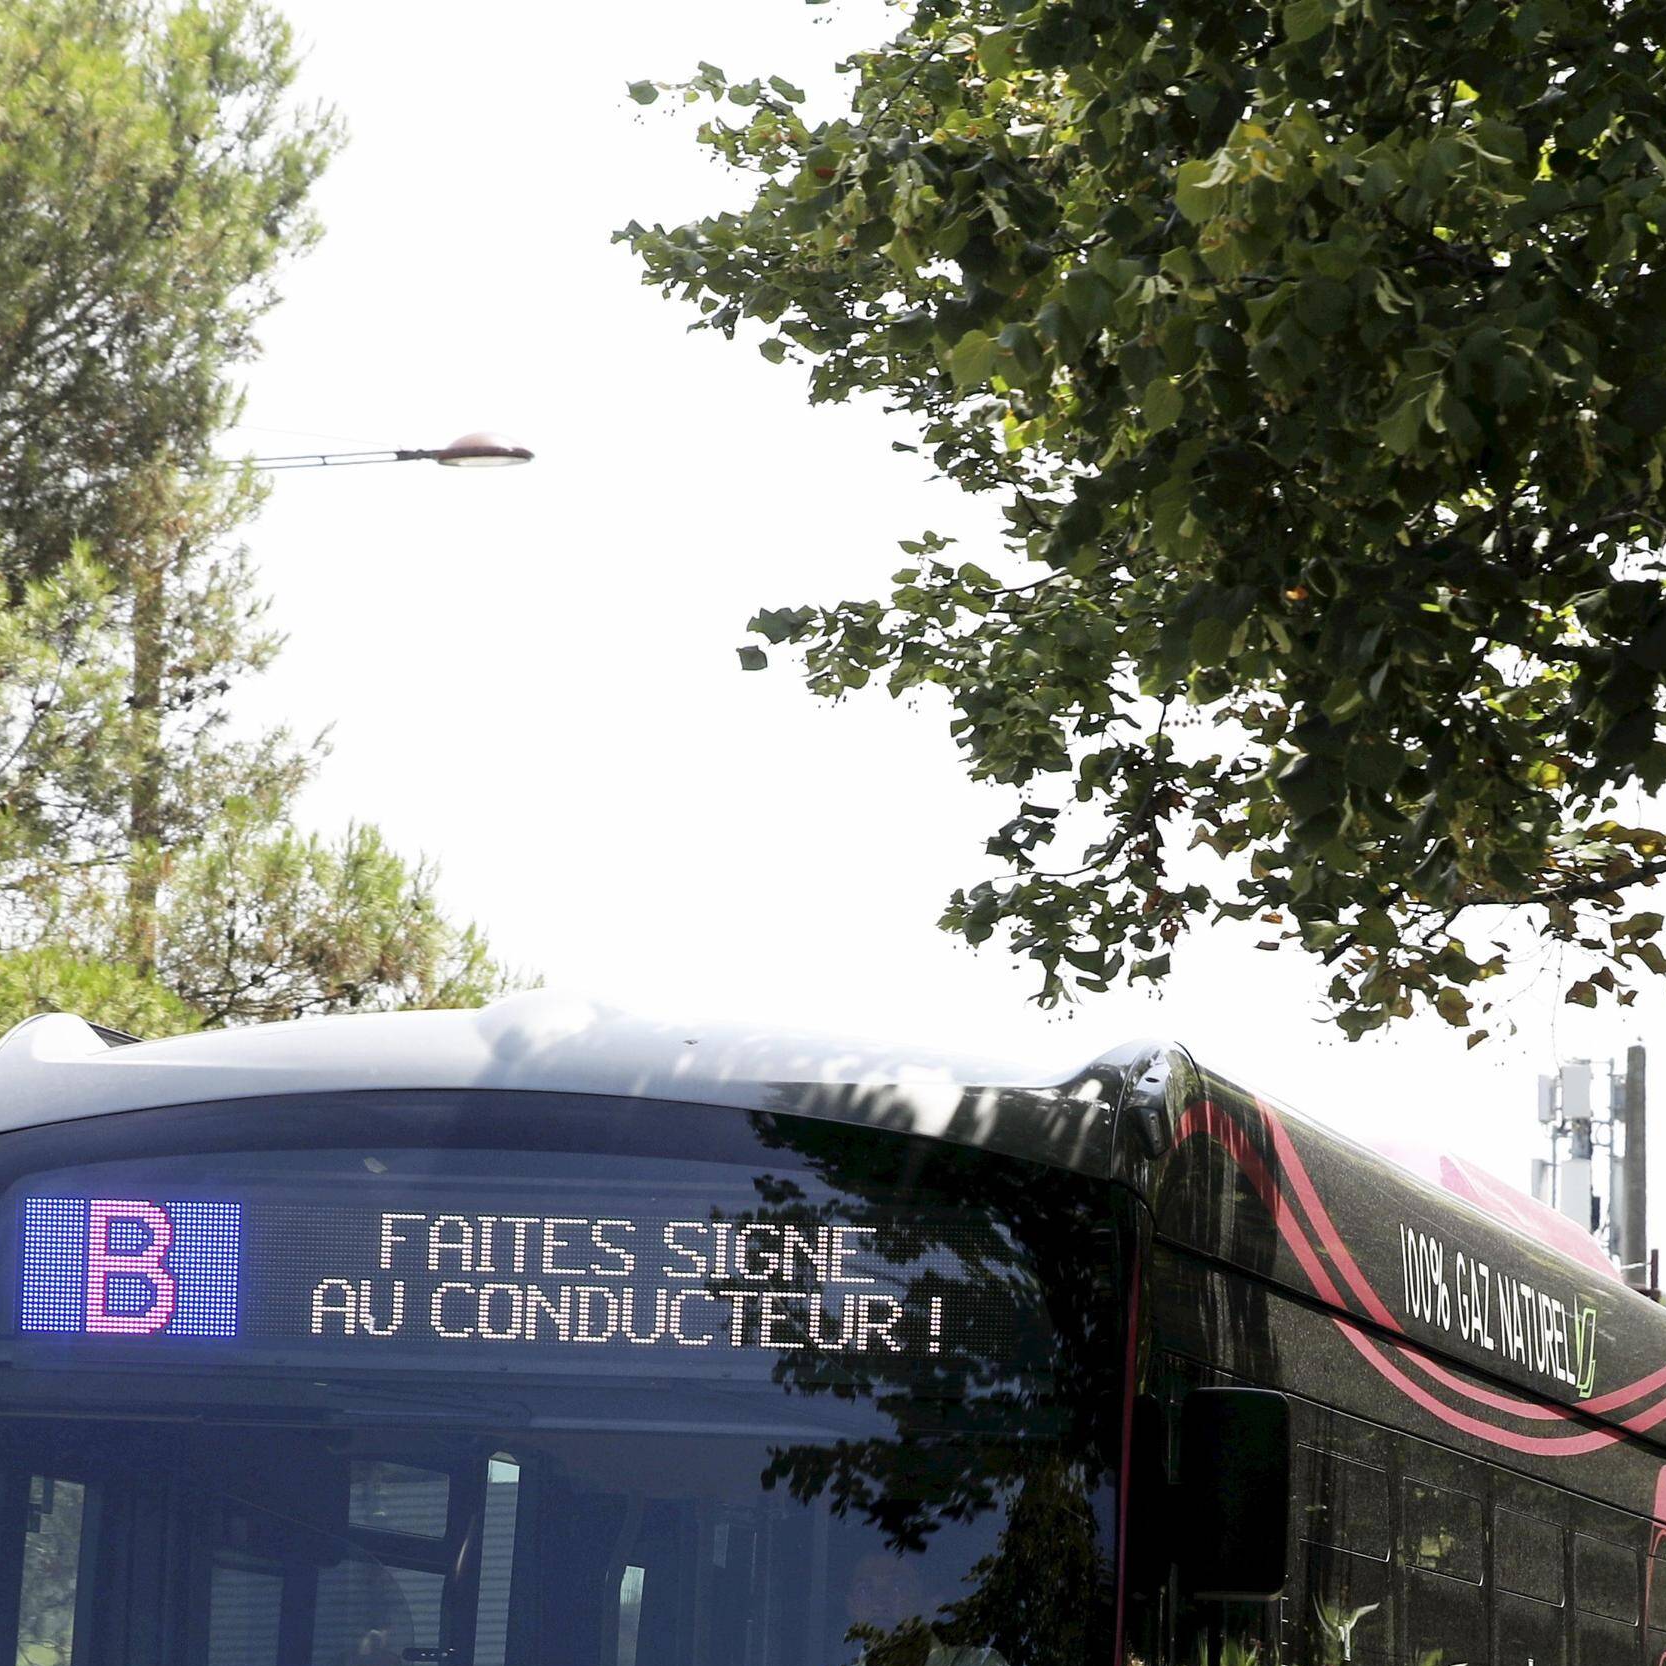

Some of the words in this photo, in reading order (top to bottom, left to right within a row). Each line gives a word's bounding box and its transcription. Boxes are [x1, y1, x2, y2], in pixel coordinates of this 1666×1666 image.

[86, 1199, 175, 1335] B
[380, 1213, 636, 1276] FAITES
[662, 1220, 877, 1284] SIGNE
[310, 1278, 405, 1335] AU
[429, 1281, 903, 1352] CONDUCTEUR
[1399, 1223, 1451, 1332] 100%
[1455, 1251, 1495, 1351] GAZ
[1497, 1271, 1577, 1386] NATUREL
